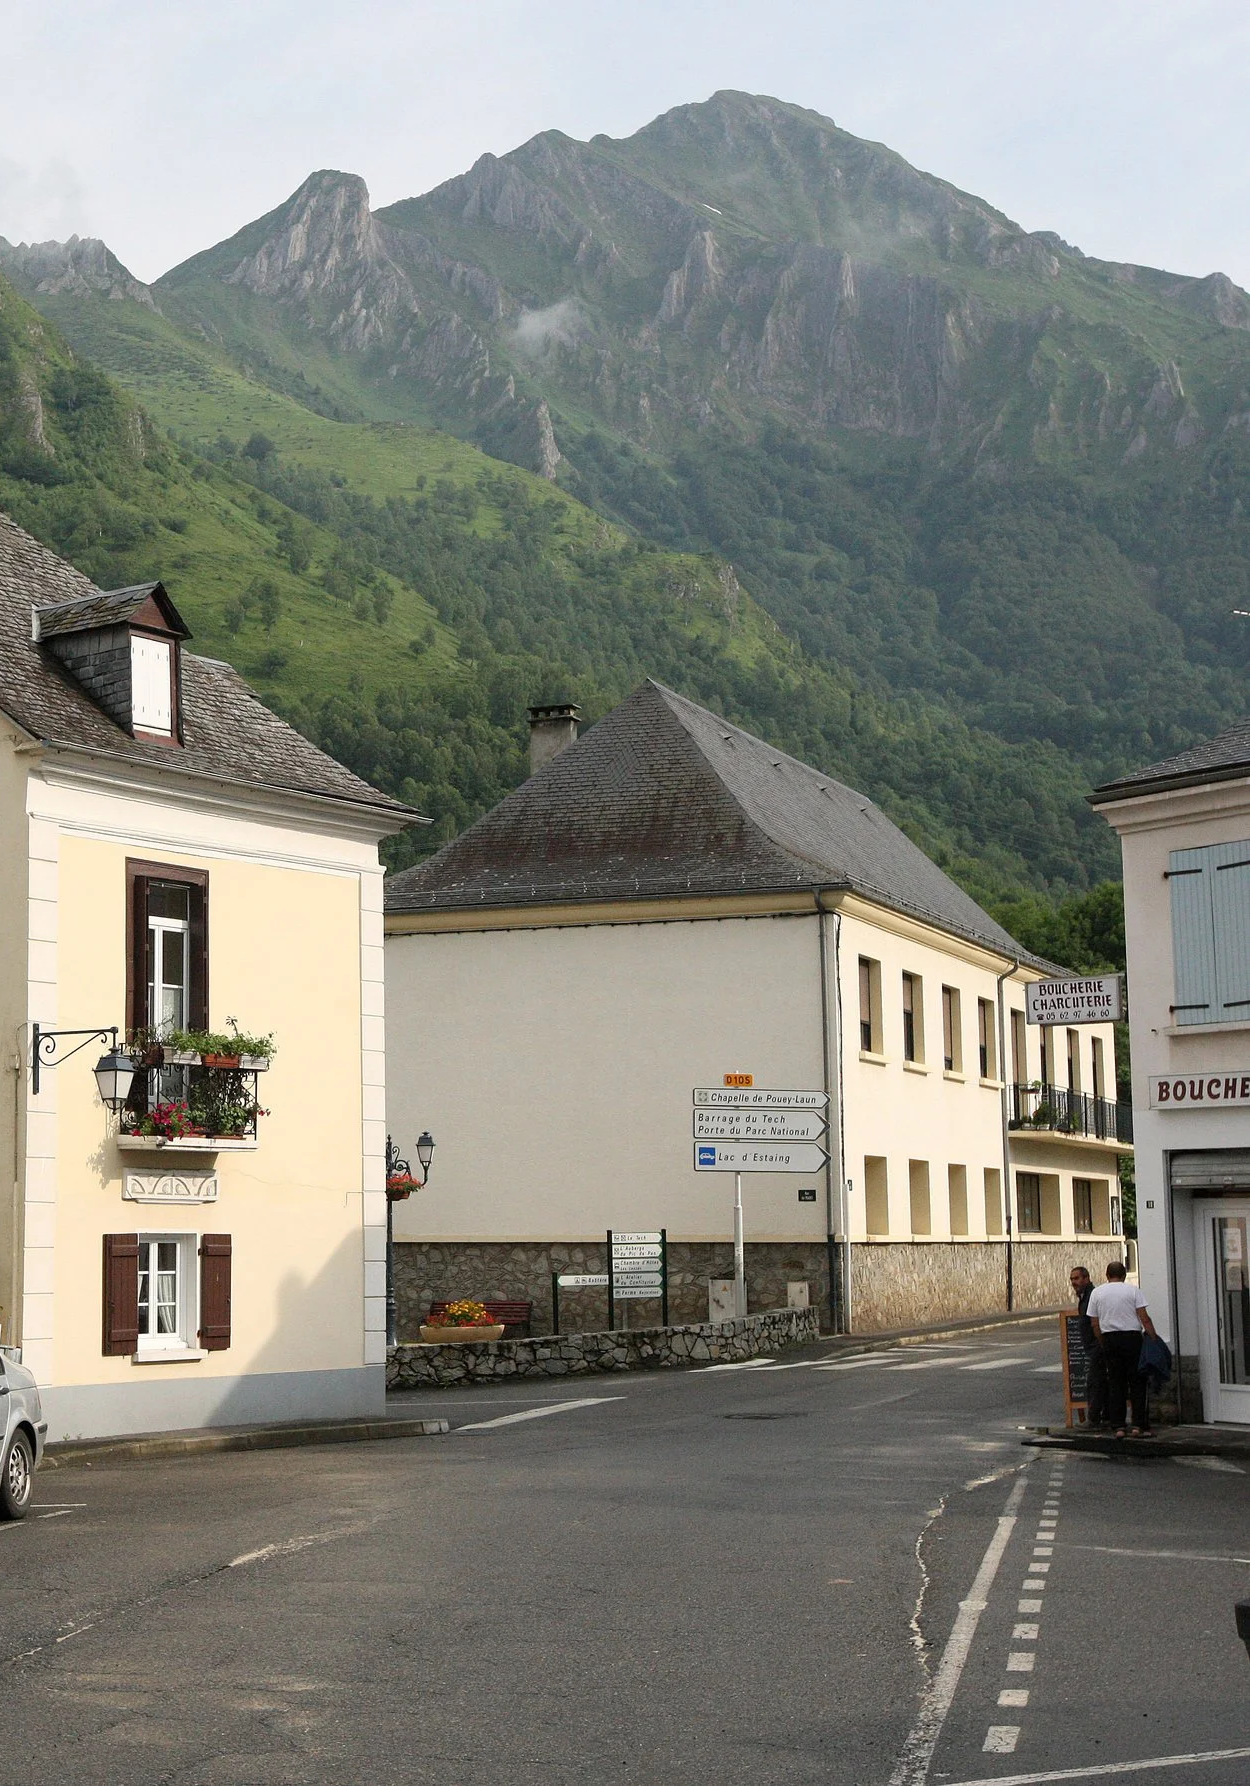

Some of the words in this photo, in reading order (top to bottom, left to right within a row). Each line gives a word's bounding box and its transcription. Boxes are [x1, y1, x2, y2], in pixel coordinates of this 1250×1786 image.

[1038, 980, 1104, 996] BOUCHERIE
[1032, 994, 1112, 1011] CHARCUTERIE
[1046, 1012, 1056, 1020] 05
[1060, 1011, 1069, 1019] 62
[1073, 1011, 1082, 1019] 97
[1087, 1010, 1096, 1018] 46
[1100, 1009, 1110, 1017] 60
[1158, 1077, 1250, 1102] BOUCHE
[711, 1092, 749, 1103] Chapelle
[753, 1094, 763, 1102] de
[698, 1113, 740, 1124] Barrage
[745, 1114, 757, 1123] du
[762, 1114, 785, 1123] Tech
[698, 1125, 725, 1134] Porte
[730, 1126, 740, 1134] du
[745, 1126, 766, 1135] Parc
[770, 1127, 809, 1136] National
[718, 1153, 735, 1161] Lac
